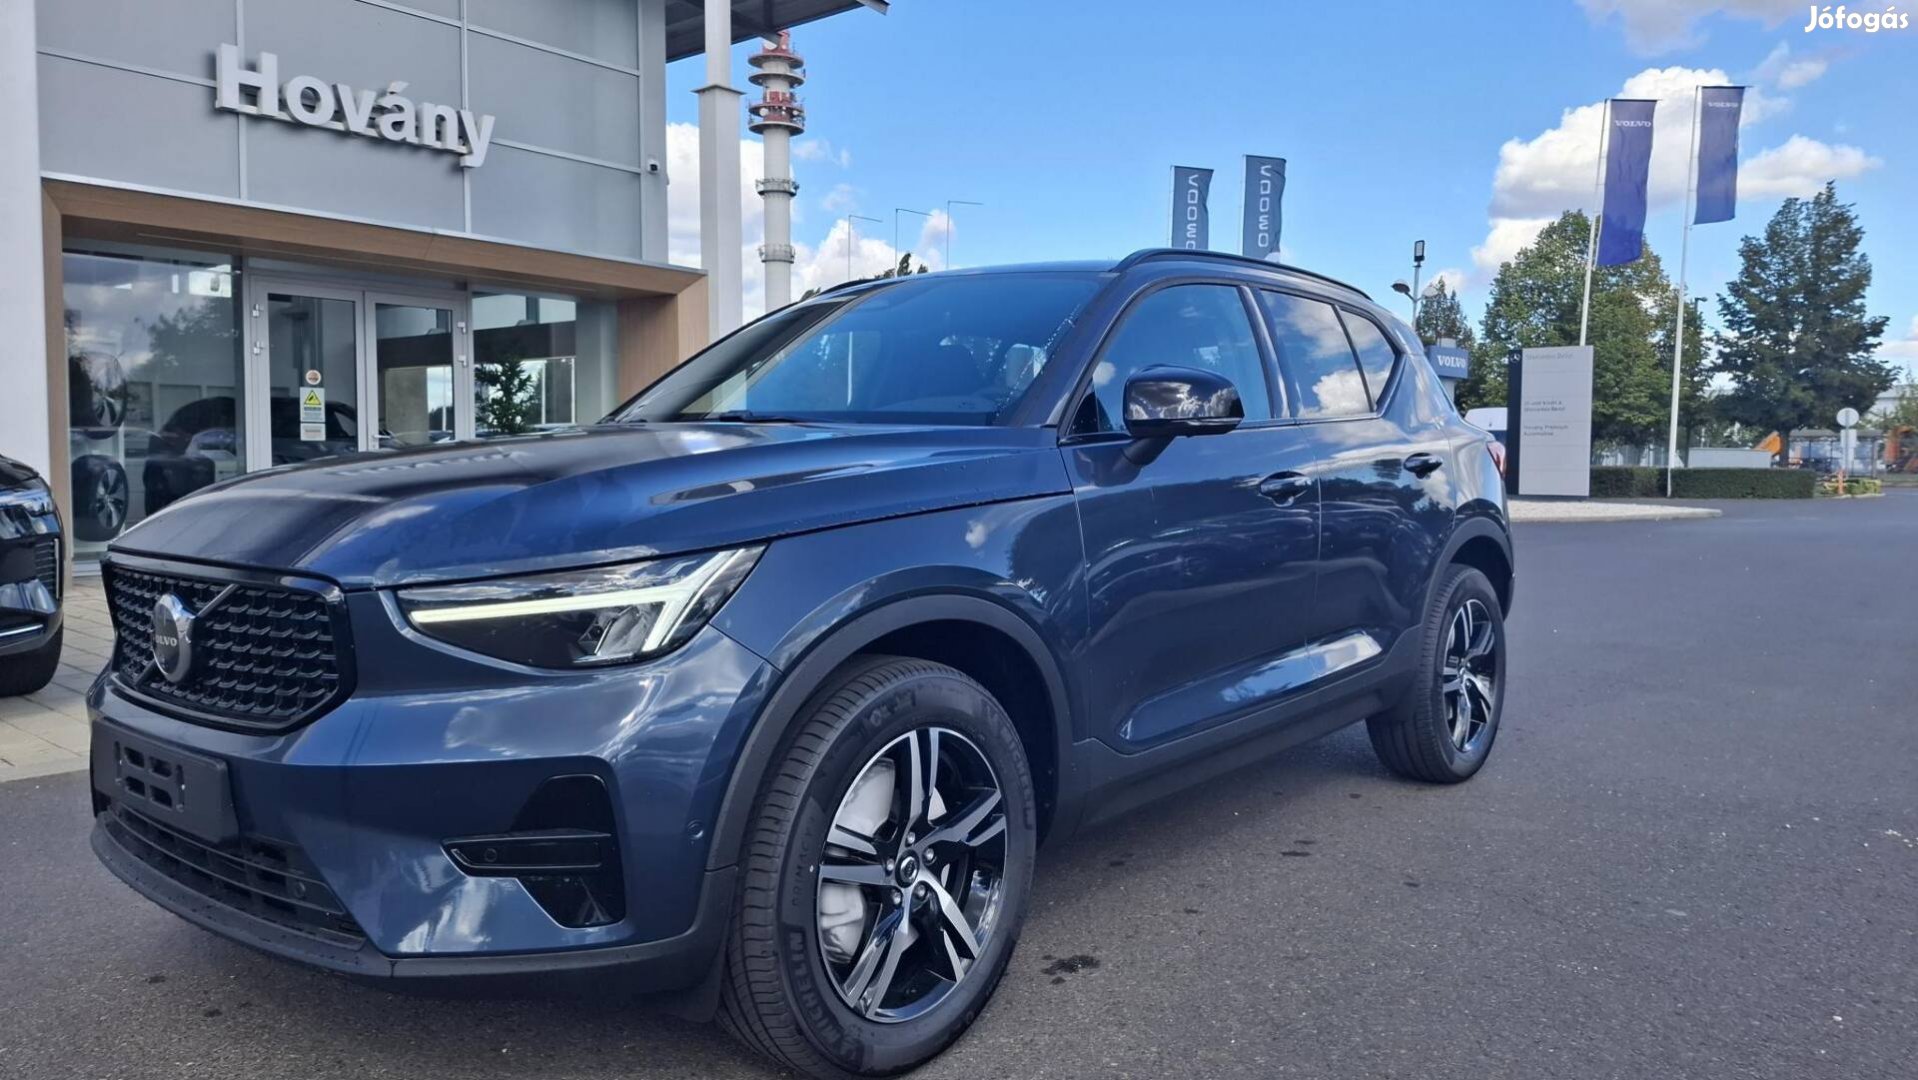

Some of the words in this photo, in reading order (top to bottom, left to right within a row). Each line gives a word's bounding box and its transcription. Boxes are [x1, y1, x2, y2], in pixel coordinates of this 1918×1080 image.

[215, 43, 496, 168] Hovány
[1615, 120, 1652, 128] VOLVO
[1436, 354, 1466, 369] VOLVO
[788, 930, 843, 1045] MICHELIN
